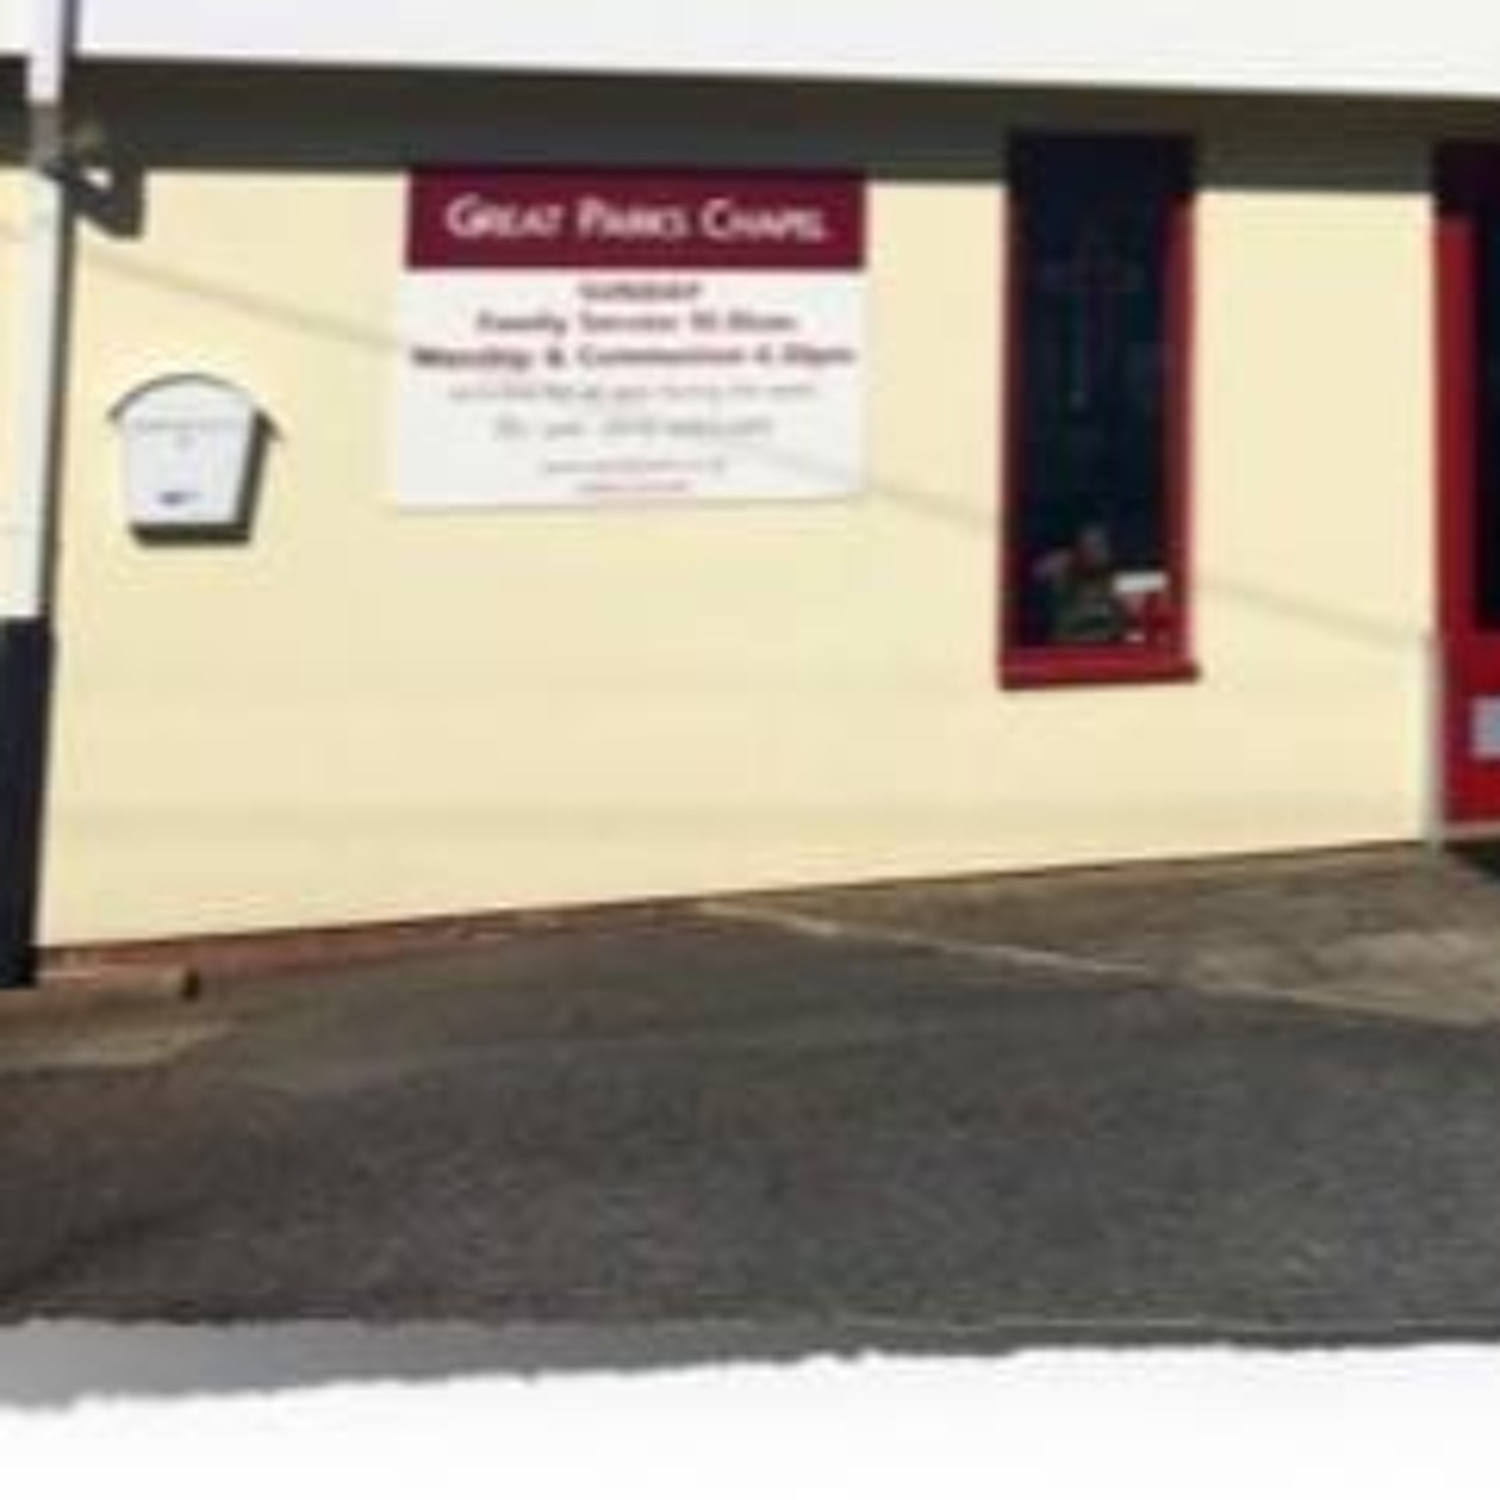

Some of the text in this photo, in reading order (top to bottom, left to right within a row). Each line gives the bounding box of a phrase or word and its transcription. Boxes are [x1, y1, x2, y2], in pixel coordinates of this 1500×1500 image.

[446, 192, 827, 242] GREAT PARKS CHAPEL
